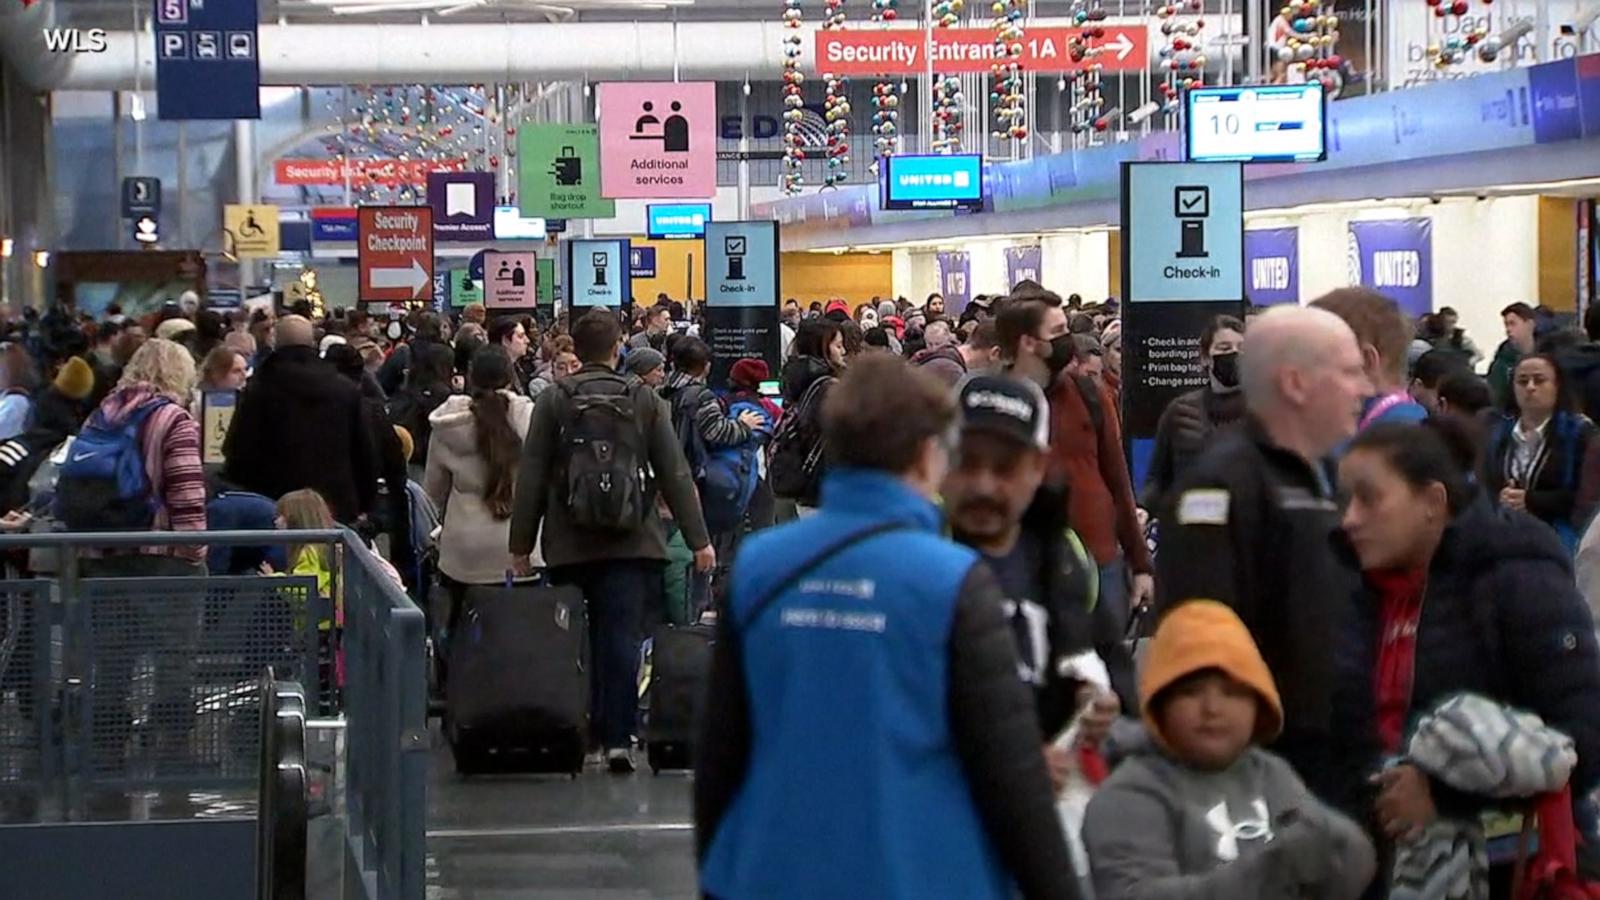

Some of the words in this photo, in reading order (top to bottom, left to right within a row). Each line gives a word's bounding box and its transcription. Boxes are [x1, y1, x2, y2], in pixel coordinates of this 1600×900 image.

[165, 0, 181, 19] 5
[827, 40, 917, 65] Security
[1028, 38, 1057, 58] 1A
[1211, 113, 1239, 135] 10
[630, 159, 688, 170] Additional
[286, 165, 337, 180] Security
[636, 174, 684, 184] services
[900, 174, 952, 185] UNITED
[550, 192, 566, 202] Bag
[568, 192, 586, 202] drop
[375, 211, 418, 232] Security
[367, 233, 427, 254] Checkpoint
[1163, 266, 1220, 279] Check-in
[1252, 257, 1289, 290] UNITED
[1372, 251, 1420, 288] UNITED
[720, 284, 755, 293] Check-in
[1147, 337, 1176, 347] Check
[1177, 337, 1186, 346] in
[1149, 349, 1187, 359] boarding
[1189, 351, 1200, 359] pa
[1148, 363, 1169, 372] Print
[1170, 363, 1188, 373] bag
[1188, 363, 1202, 373] tag
[1147, 376, 1183, 387] Change
[1184, 377, 1201, 386] seat
